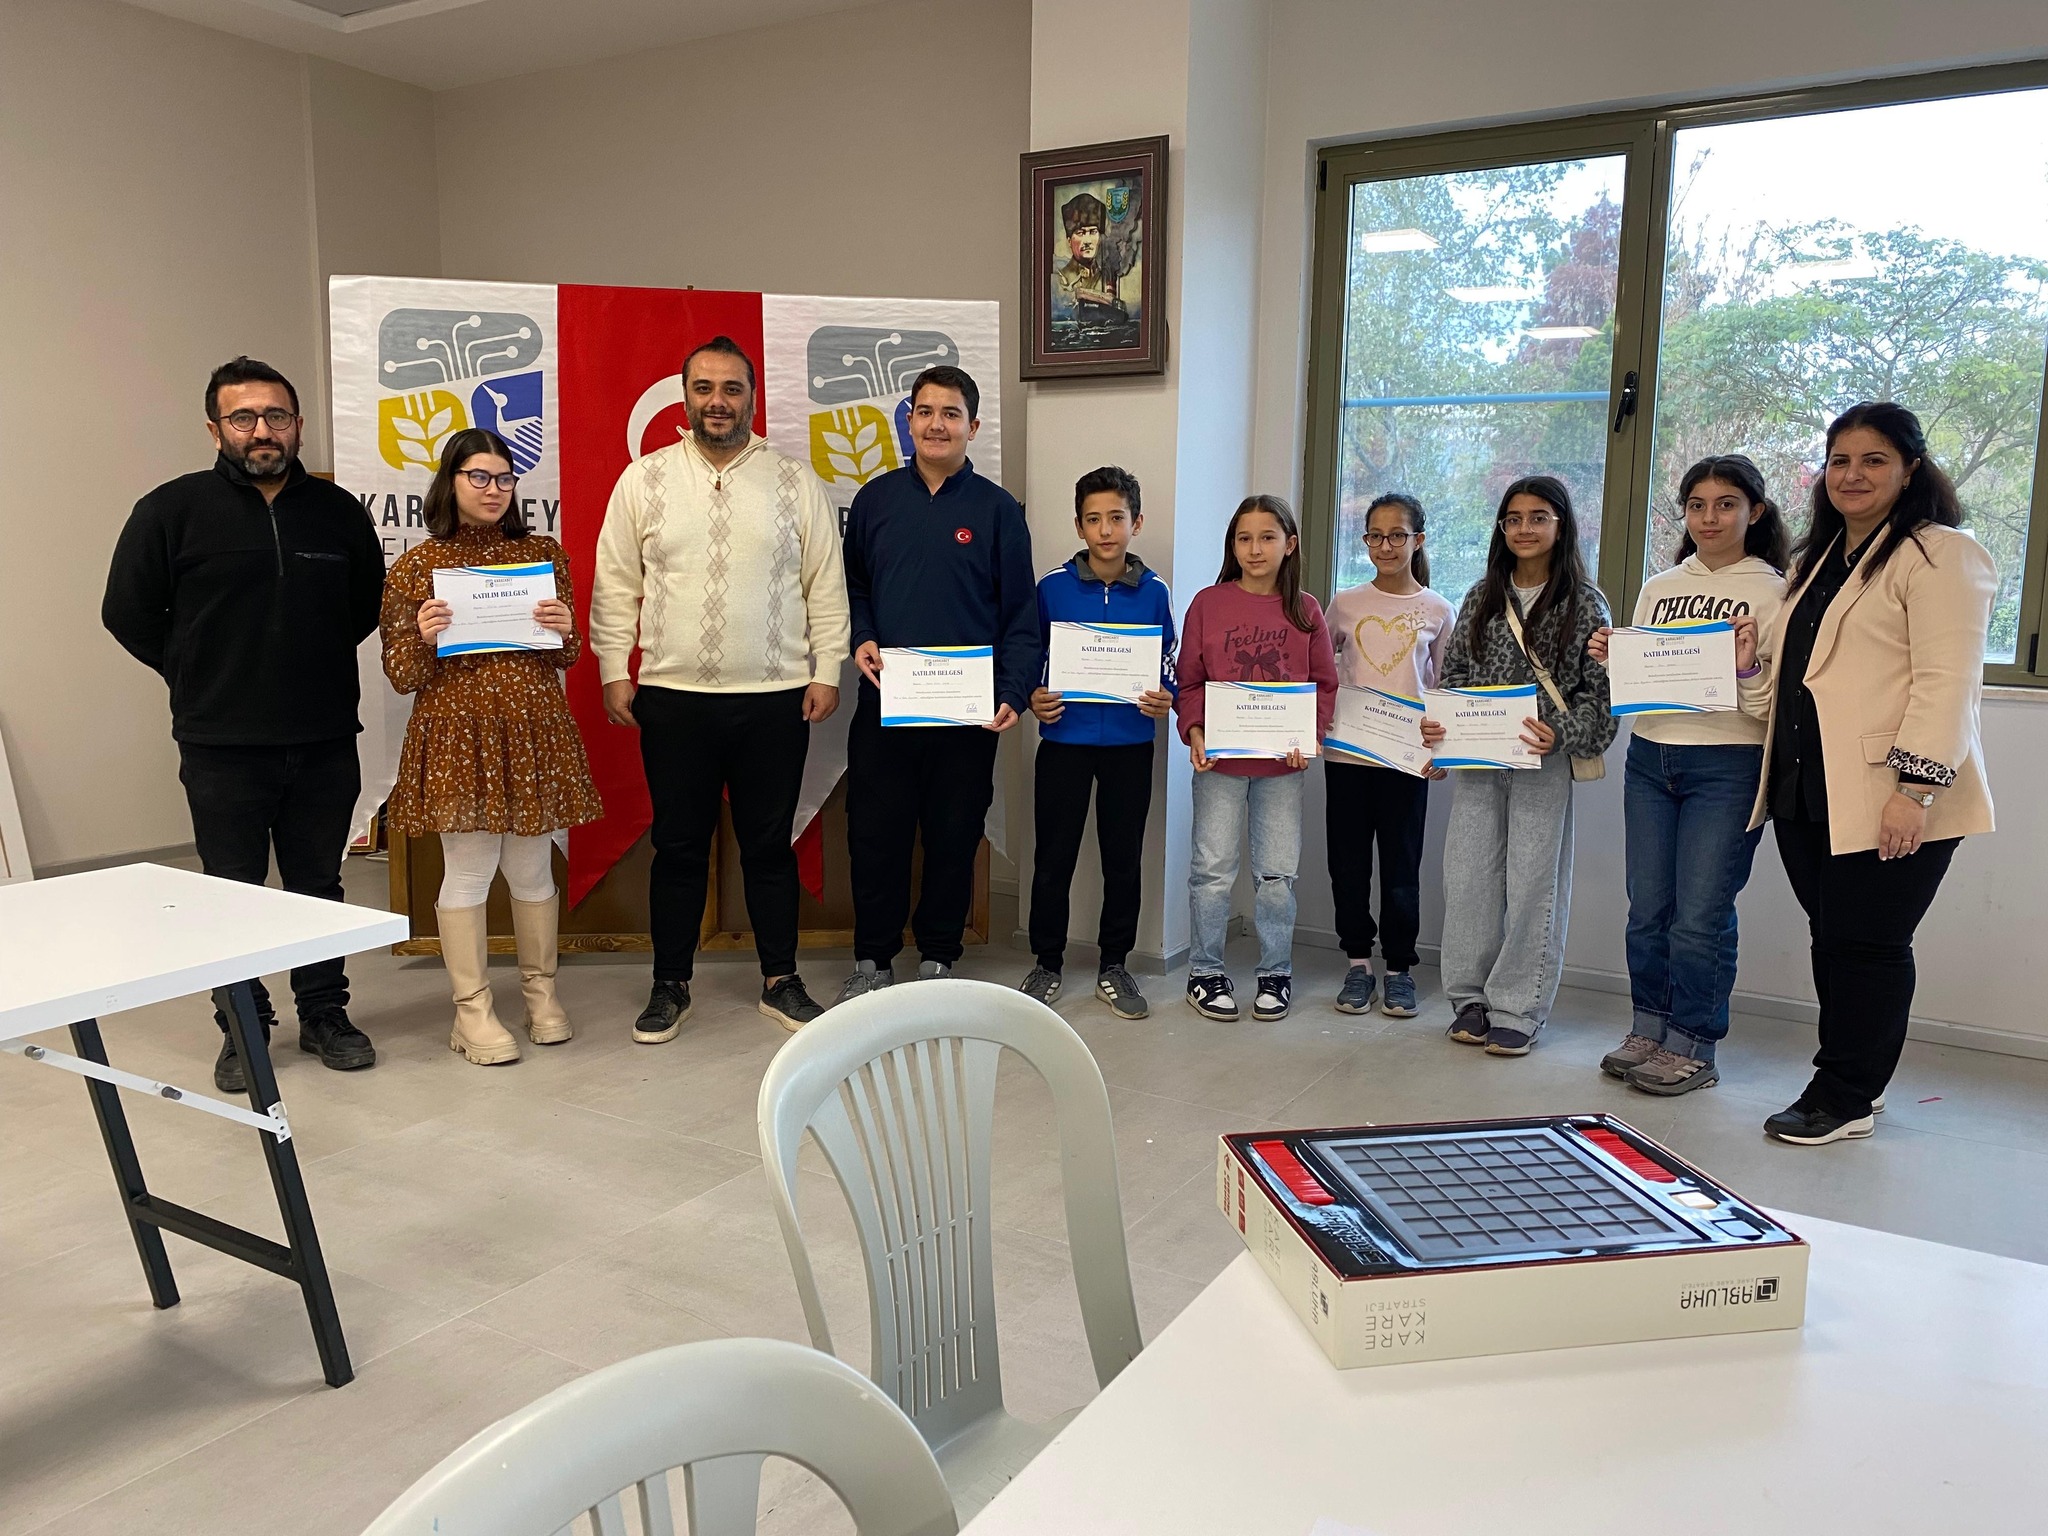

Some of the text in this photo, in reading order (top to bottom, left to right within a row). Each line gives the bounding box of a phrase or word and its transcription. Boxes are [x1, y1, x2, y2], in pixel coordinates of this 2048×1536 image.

[360, 493, 561, 532] KAREY
[472, 588, 528, 600] KATILIM BELGESİ
[1651, 594, 1750, 626] CHICAGO
[1224, 626, 1288, 653] Feeling
[1081, 645, 1132, 654] KATILIM BELGESİ
[1643, 647, 1700, 658] KATILIM BELGESİ
[937, 668, 963, 676] BELGESİ
[1261, 703, 1287, 711] BELGESİ
[1364, 705, 1388, 717] KATILIM
[1388, 712, 1413, 724] BELGESİ
[1480, 709, 1507, 717] BELGESİ
[1681, 1285, 1753, 1309] ABLUKA
[1366, 1312, 1426, 1331] KARE
[1365, 1330, 1425, 1350] KARE
